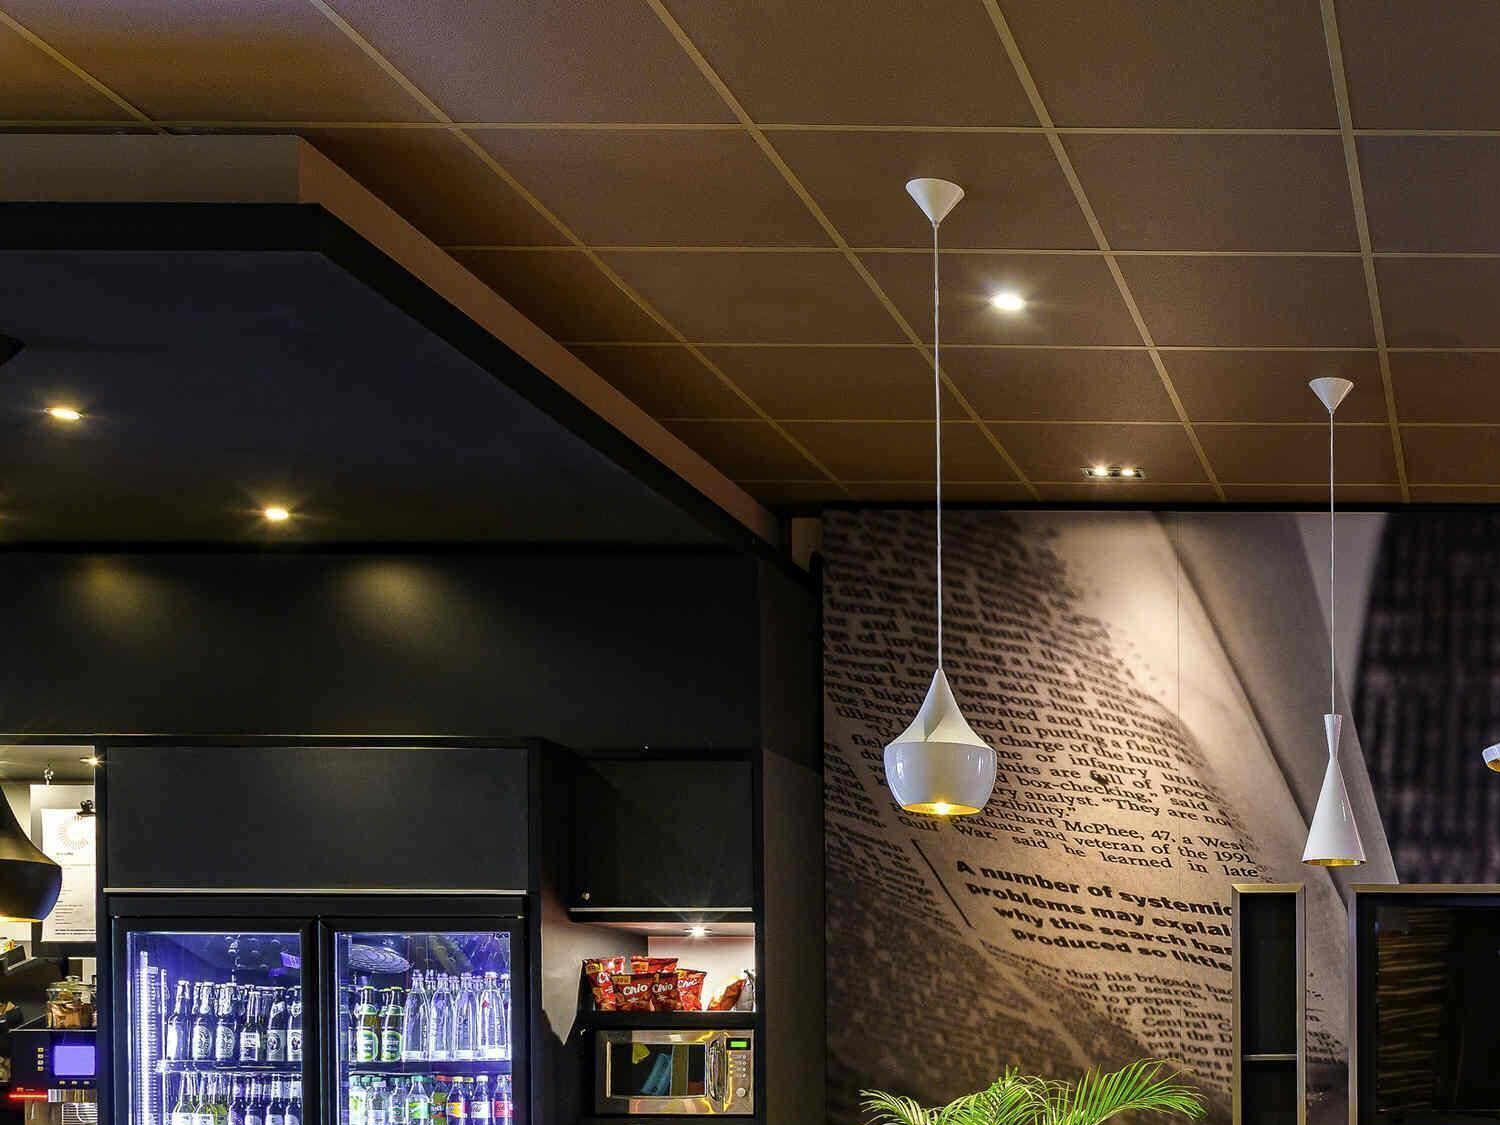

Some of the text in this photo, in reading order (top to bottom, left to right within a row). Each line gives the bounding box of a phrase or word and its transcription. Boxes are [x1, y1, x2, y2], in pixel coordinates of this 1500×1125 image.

[998, 680, 1039, 695] said
[961, 702, 1040, 722] otivated
[1047, 714, 1083, 728] and
[1010, 720, 1032, 735] in
[1035, 727, 1108, 749] putting
[1111, 740, 1122, 749] a
[1126, 739, 1170, 758] field
[1000, 735, 1065, 752] charge
[1070, 743, 1090, 754] of
[1093, 745, 1123, 760] the
[1126, 752, 1179, 772] hunt.
[1036, 754, 1057, 763] or
[1069, 754, 1149, 779] infantry
[1050, 767, 1081, 779] are
[1132, 778, 1152, 790] of
[1023, 790, 1099, 807] analyst.
[1167, 808, 1199, 821] are
[1170, 796, 1210, 812] said
[983, 806, 1058, 829] Richard
[1061, 819, 1146, 841] McPhee,
[1151, 830, 1177, 843] 47,
[1182, 836, 1193, 845] a
[952, 822, 998, 841] War,
[1011, 836, 1050, 850] said
[1062, 843, 1087, 857] he
[1099, 850, 1173, 869] learned
[1187, 861, 1210, 874] in
[1223, 864, 1260, 878] late
[1032, 828, 1067, 841] and
[1073, 836, 1145, 853] veteran
[1151, 844, 1171, 855] of
[1177, 845, 1208, 860] the
[1215, 851, 1257, 865] 1991
[956, 860, 1232, 917] A number of systemic
[965, 882, 1232, 938] problems may explai
[993, 906, 1043, 929] why
[1049, 917, 1094, 933] the
[1099, 926, 1187, 947] search
[1011, 928, 1232, 971] produced so little
[622, 983, 649, 996] Chio
[652, 982, 674, 994] Chio
[1103, 971, 1132, 981] his
[1135, 972, 1201, 990] brigade
[1108, 982, 1137, 993] the
[1102, 995, 1120, 1004] to
[1124, 995, 1198, 1009] prepare.
[1143, 1005, 1172, 1016] the
[1142, 1016, 1208, 1030] Central
[1186, 1030, 1214, 1041] the
